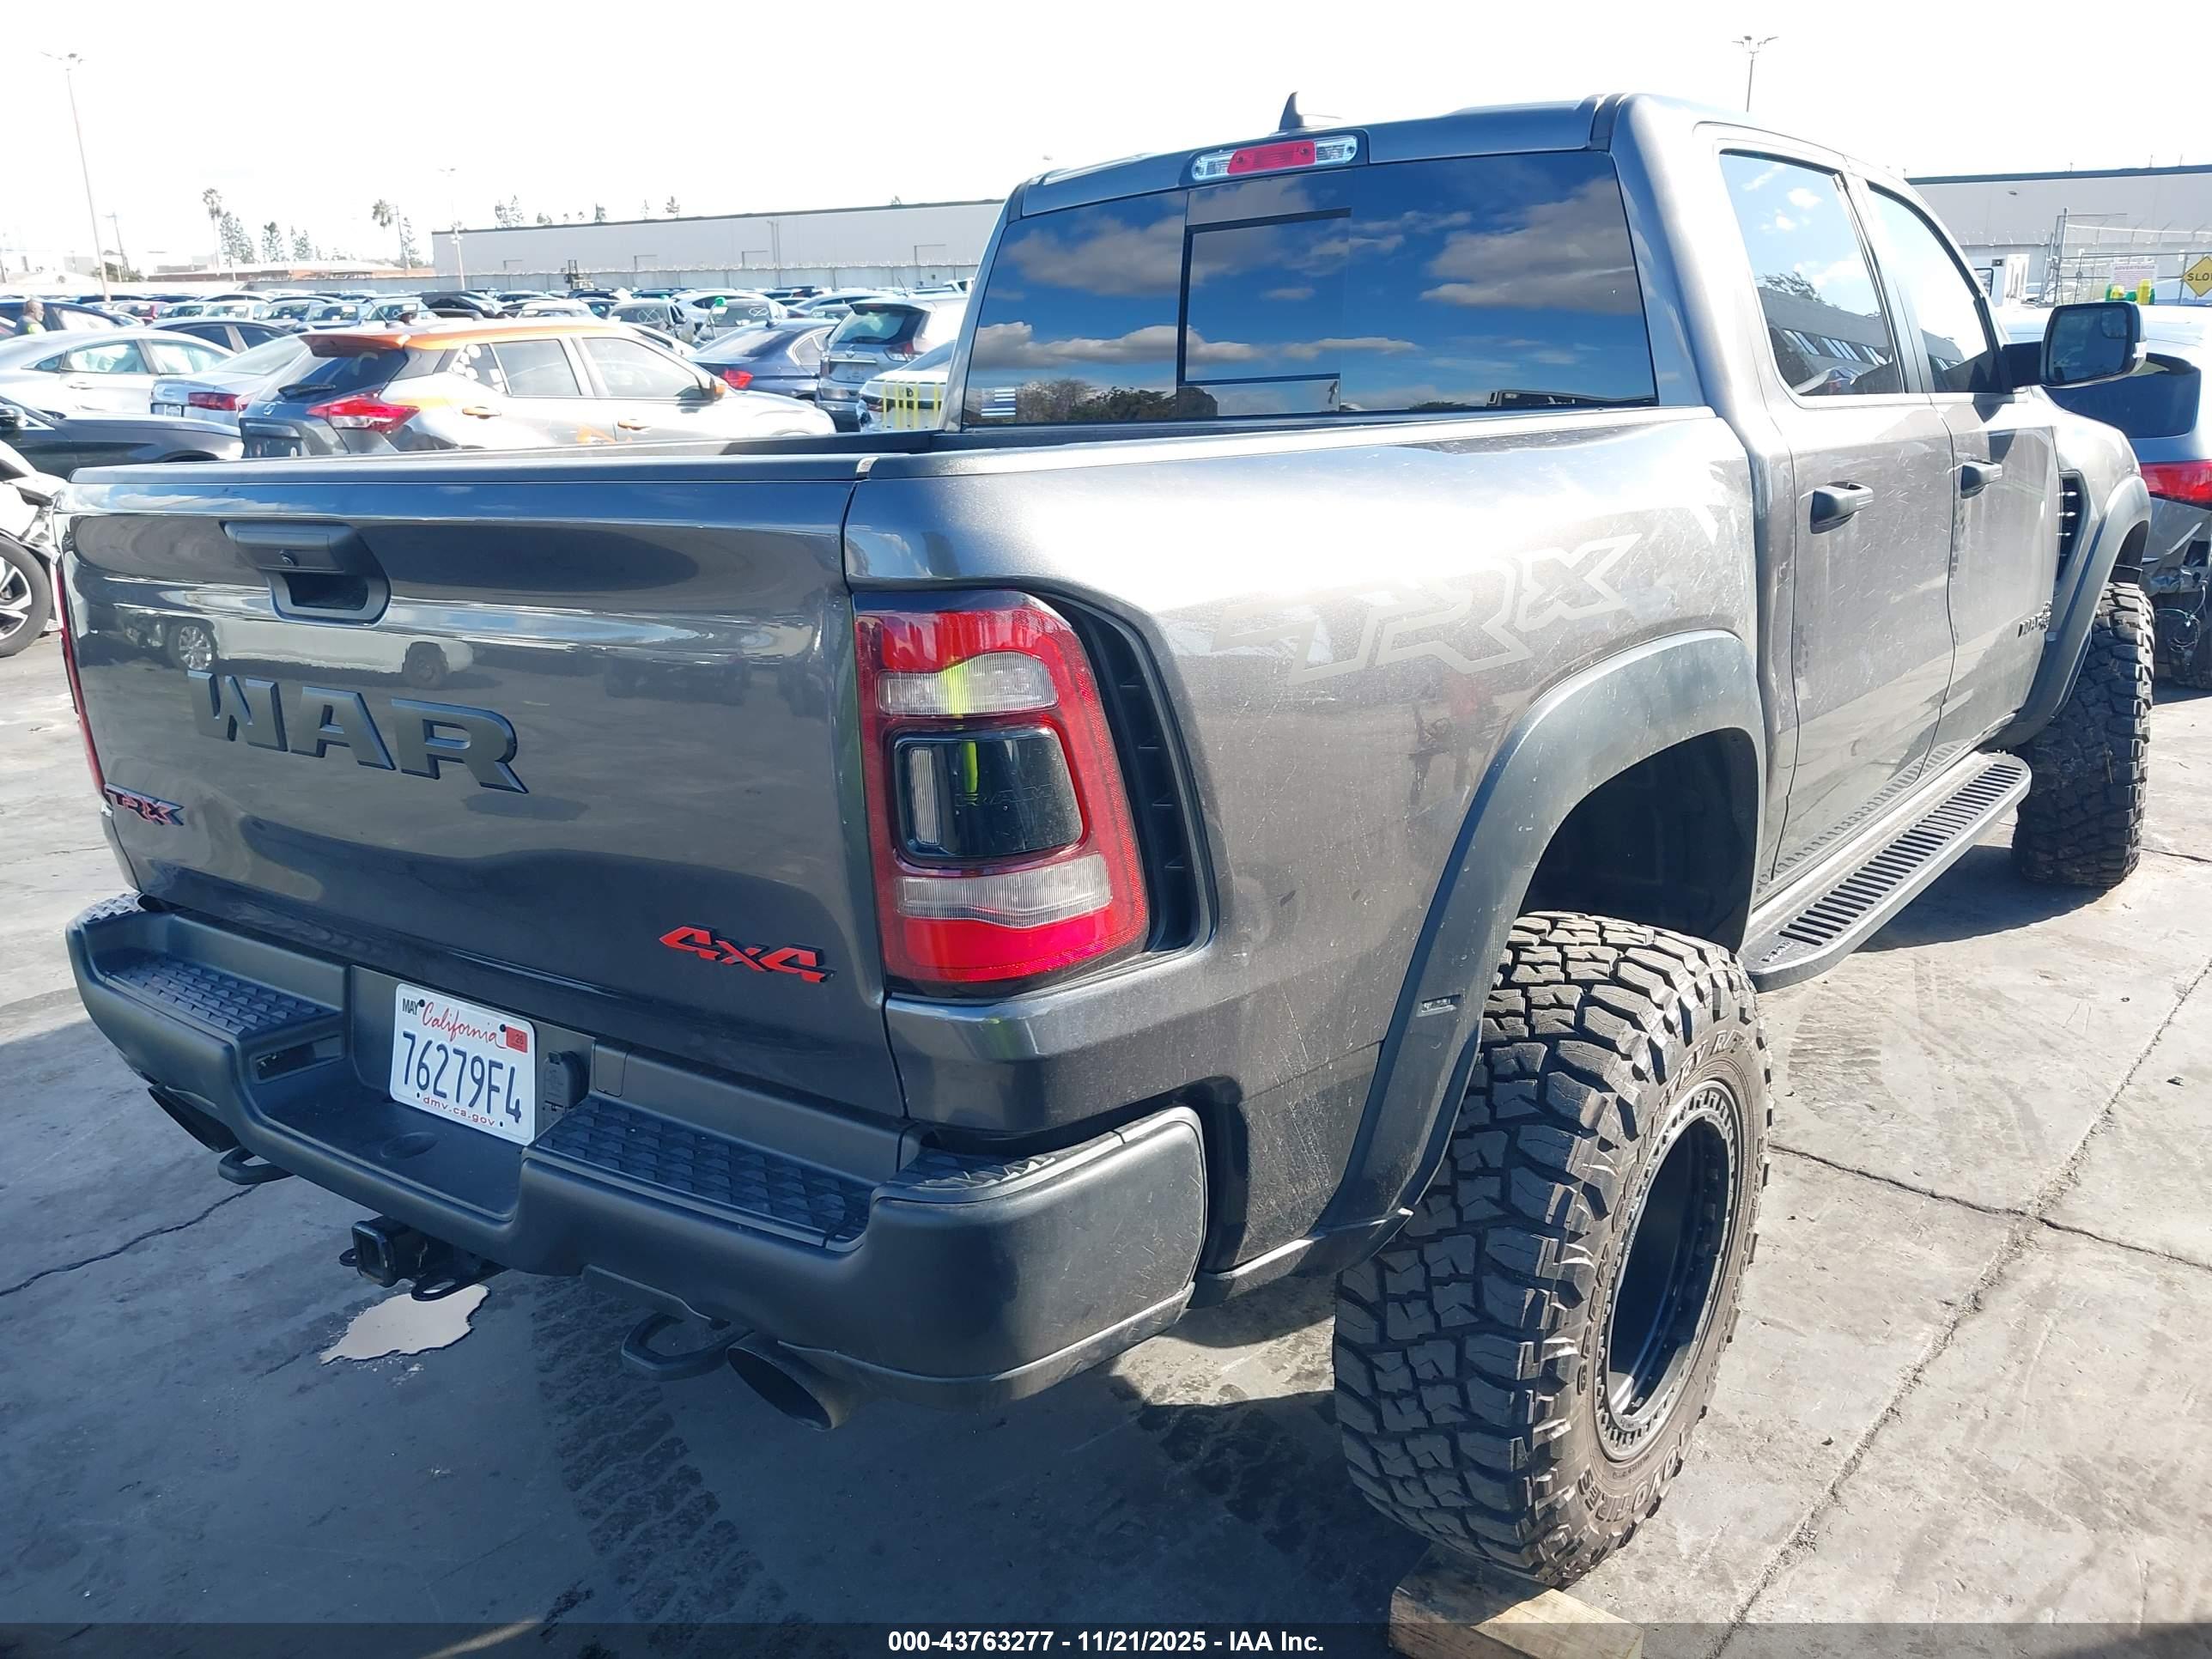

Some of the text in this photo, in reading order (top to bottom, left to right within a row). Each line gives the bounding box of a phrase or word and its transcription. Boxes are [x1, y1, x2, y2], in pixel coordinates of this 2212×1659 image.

[1209, 532, 1644, 687] TRX
[186, 668, 530, 794] WAR
[104, 782, 185, 826] TRX
[402, 997, 419, 1017] MAY
[421, 1001, 507, 1049] California
[402, 1030, 522, 1124] 76279F4
[422, 1095, 496, 1127] dmv.ca.gov
